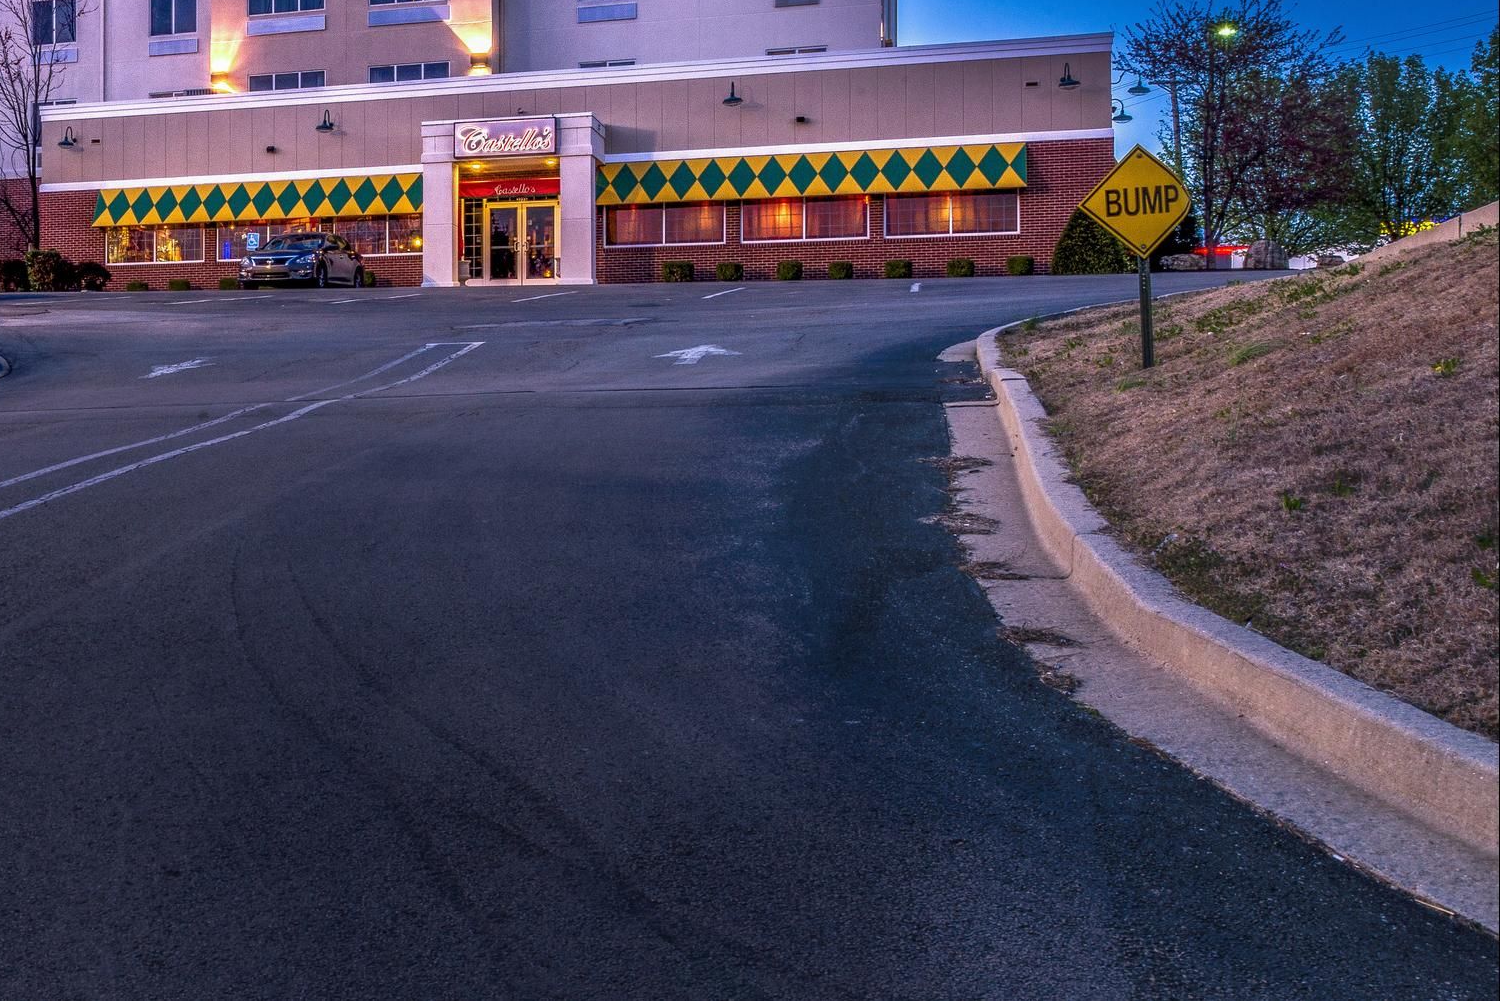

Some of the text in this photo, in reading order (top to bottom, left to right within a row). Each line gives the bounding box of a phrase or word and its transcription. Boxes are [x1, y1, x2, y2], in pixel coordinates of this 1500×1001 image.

[458, 125, 553, 154] Castello's
[495, 183, 536, 195] Castello's
[1105, 185, 1178, 217] BUMP
